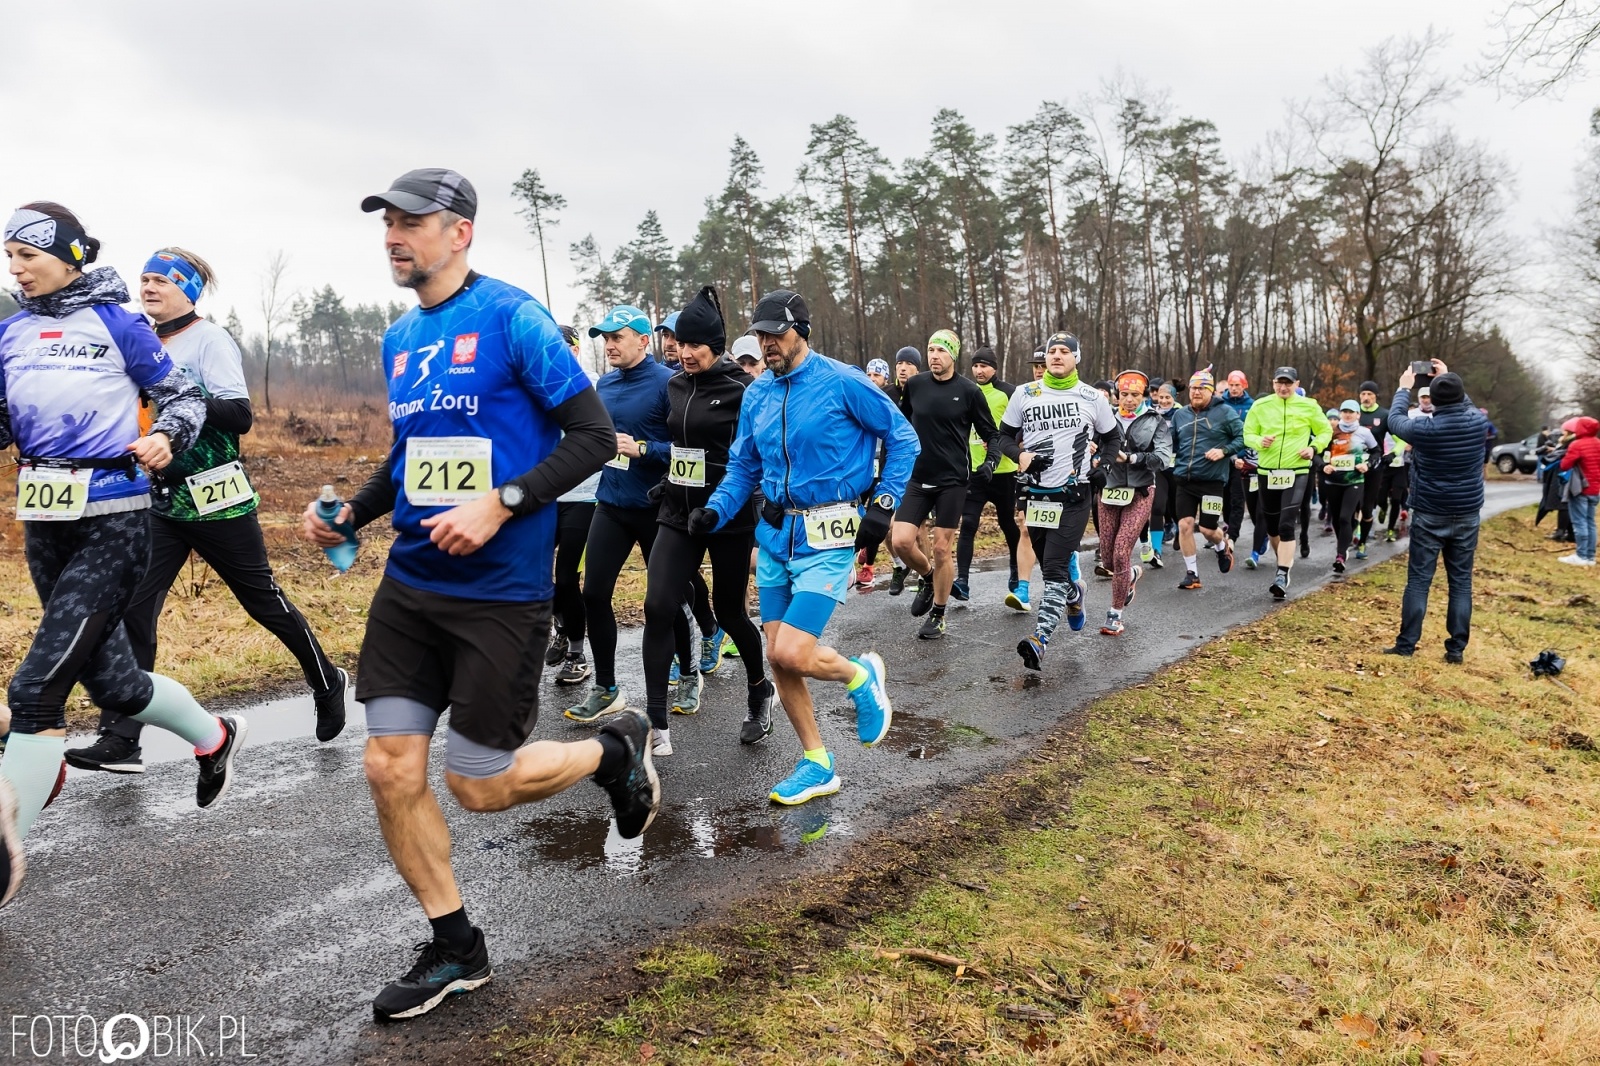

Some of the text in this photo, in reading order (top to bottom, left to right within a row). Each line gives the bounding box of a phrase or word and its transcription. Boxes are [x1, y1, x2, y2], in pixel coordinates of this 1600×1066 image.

[448, 366, 476, 375] POLSKA
[430, 383, 479, 416] Żory
[1038, 421, 1050, 431] JO
[1052, 417, 1082, 430] LECA?
[1335, 460, 1351, 468] 255
[417, 461, 476, 490] 212
[1272, 476, 1291, 485] 214
[25, 483, 74, 509] 204
[202, 476, 240, 505] 271
[1107, 488, 1129, 501] 220
[1207, 502, 1222, 512] 186
[1032, 509, 1056, 523] 159
[817, 517, 857, 541] 164
